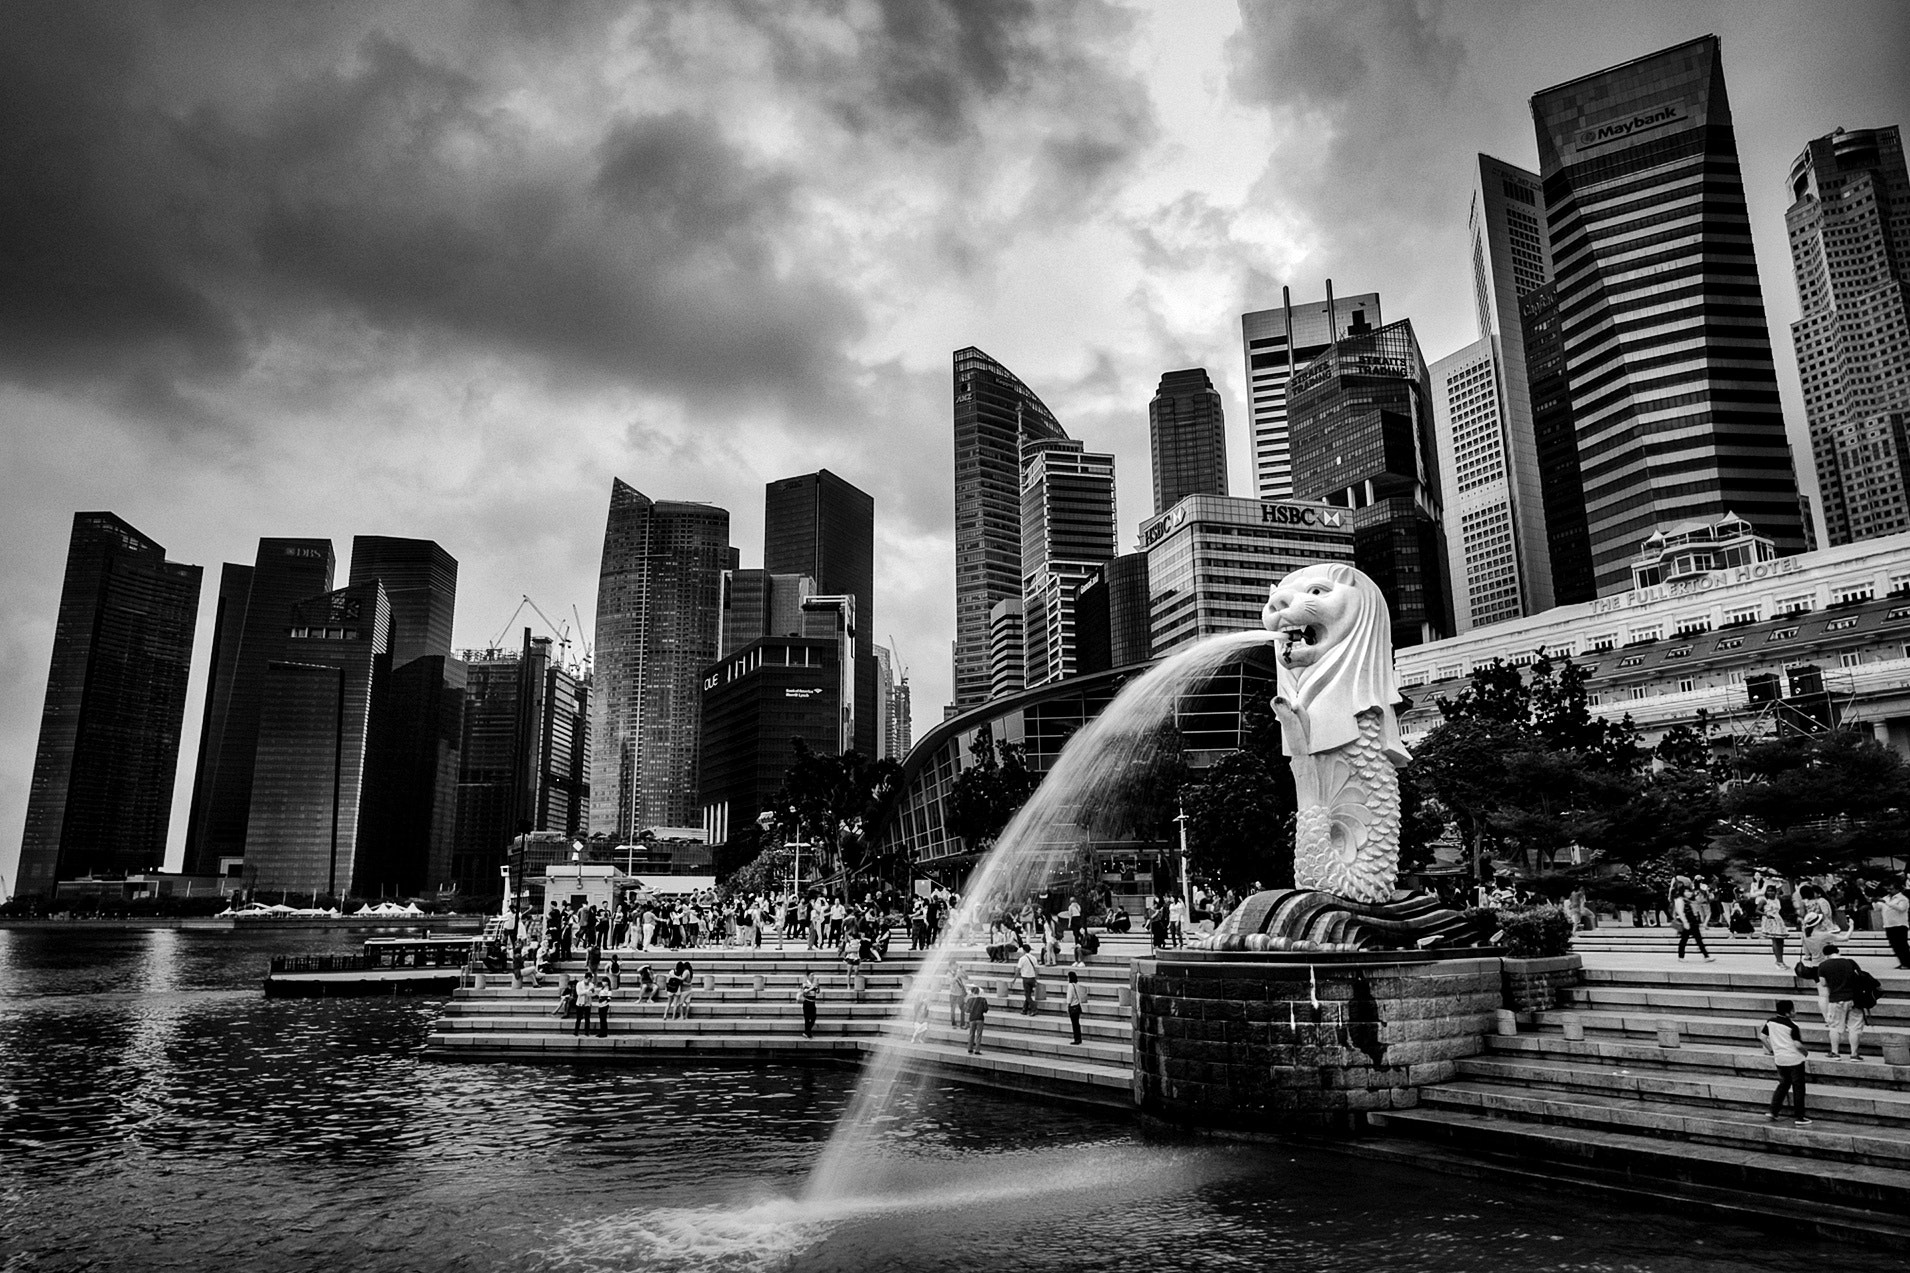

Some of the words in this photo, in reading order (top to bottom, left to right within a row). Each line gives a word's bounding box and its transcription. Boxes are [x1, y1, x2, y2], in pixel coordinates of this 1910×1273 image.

[1598, 107, 1676, 140] Maybank
[1359, 356, 1407, 366] STRAITS
[1358, 365, 1408, 378] TRADING
[1260, 503, 1316, 526] HSBC
[1145, 514, 1171, 547] HSBC
[296, 548, 321, 558] DBS
[1589, 596, 1621, 614] THE
[1626, 572, 1727, 606] FULLERTON
[1735, 556, 1803, 582] HOTEL
[704, 673, 719, 691] OUE
